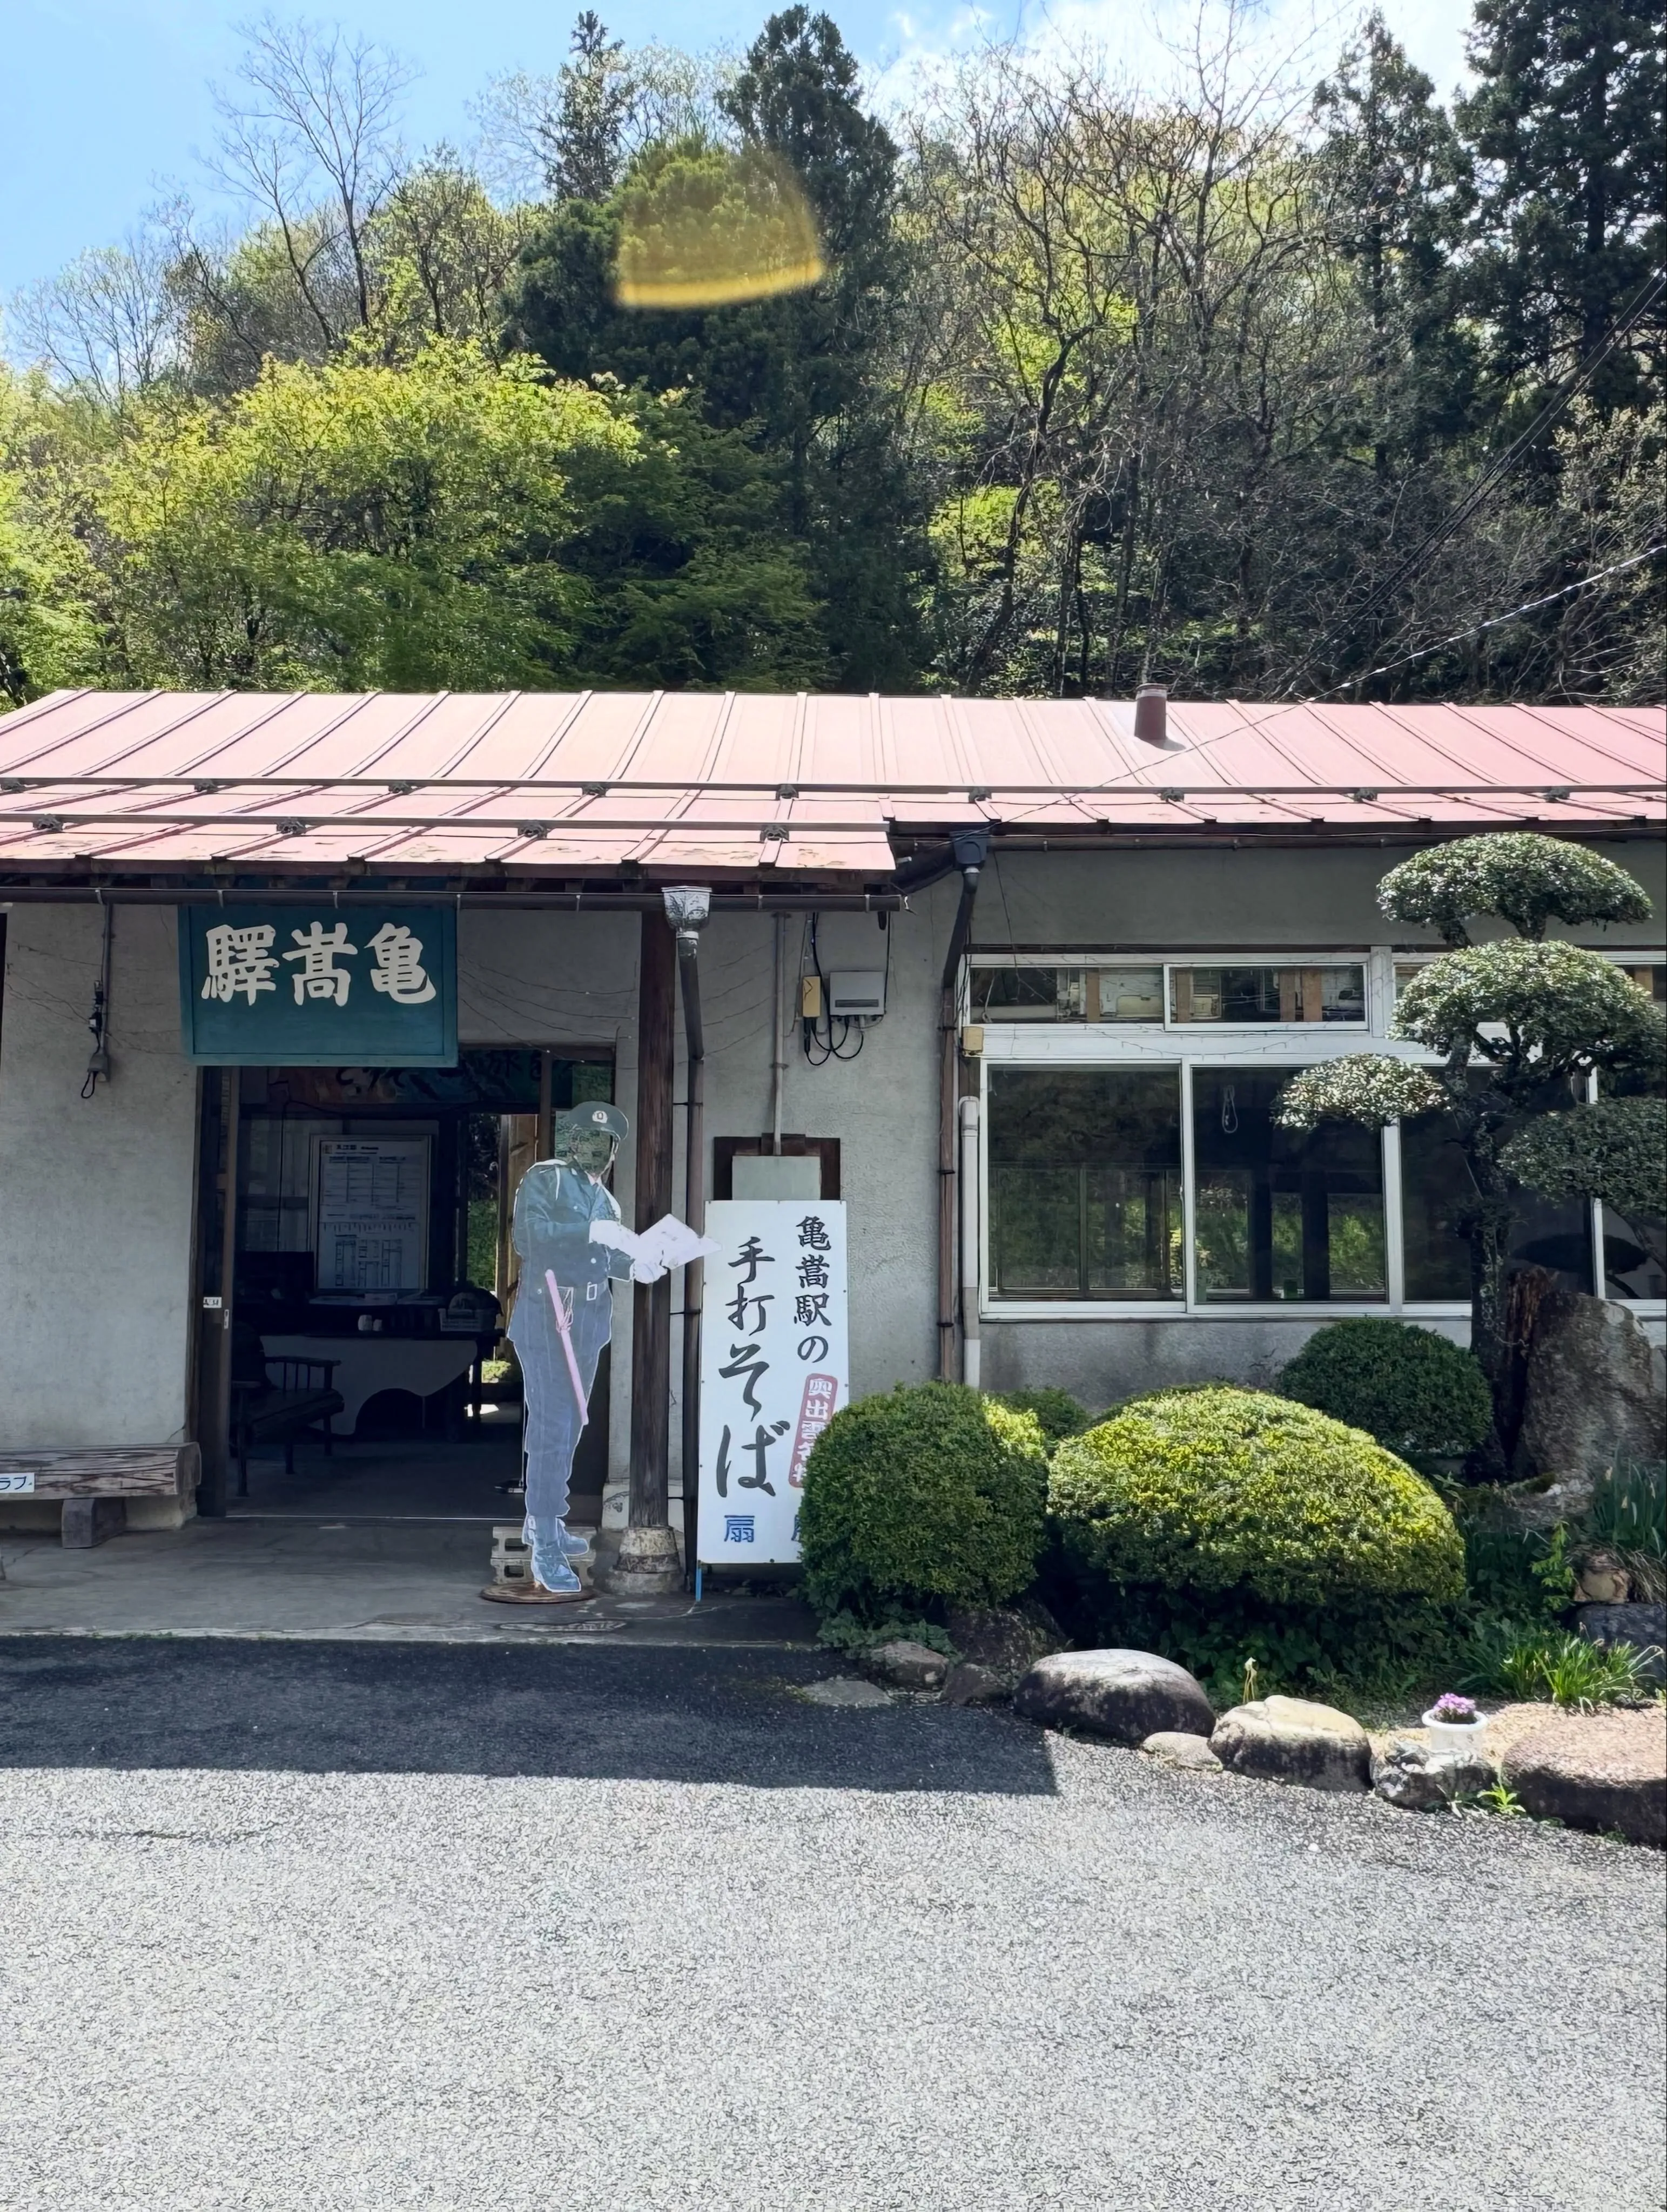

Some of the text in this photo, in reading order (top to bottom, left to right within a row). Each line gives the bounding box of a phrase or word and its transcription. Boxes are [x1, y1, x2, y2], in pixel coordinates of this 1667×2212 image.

[716, 1236, 791, 1498] 手打そば
[794, 1216, 832, 1363] 亀嵩駅の
